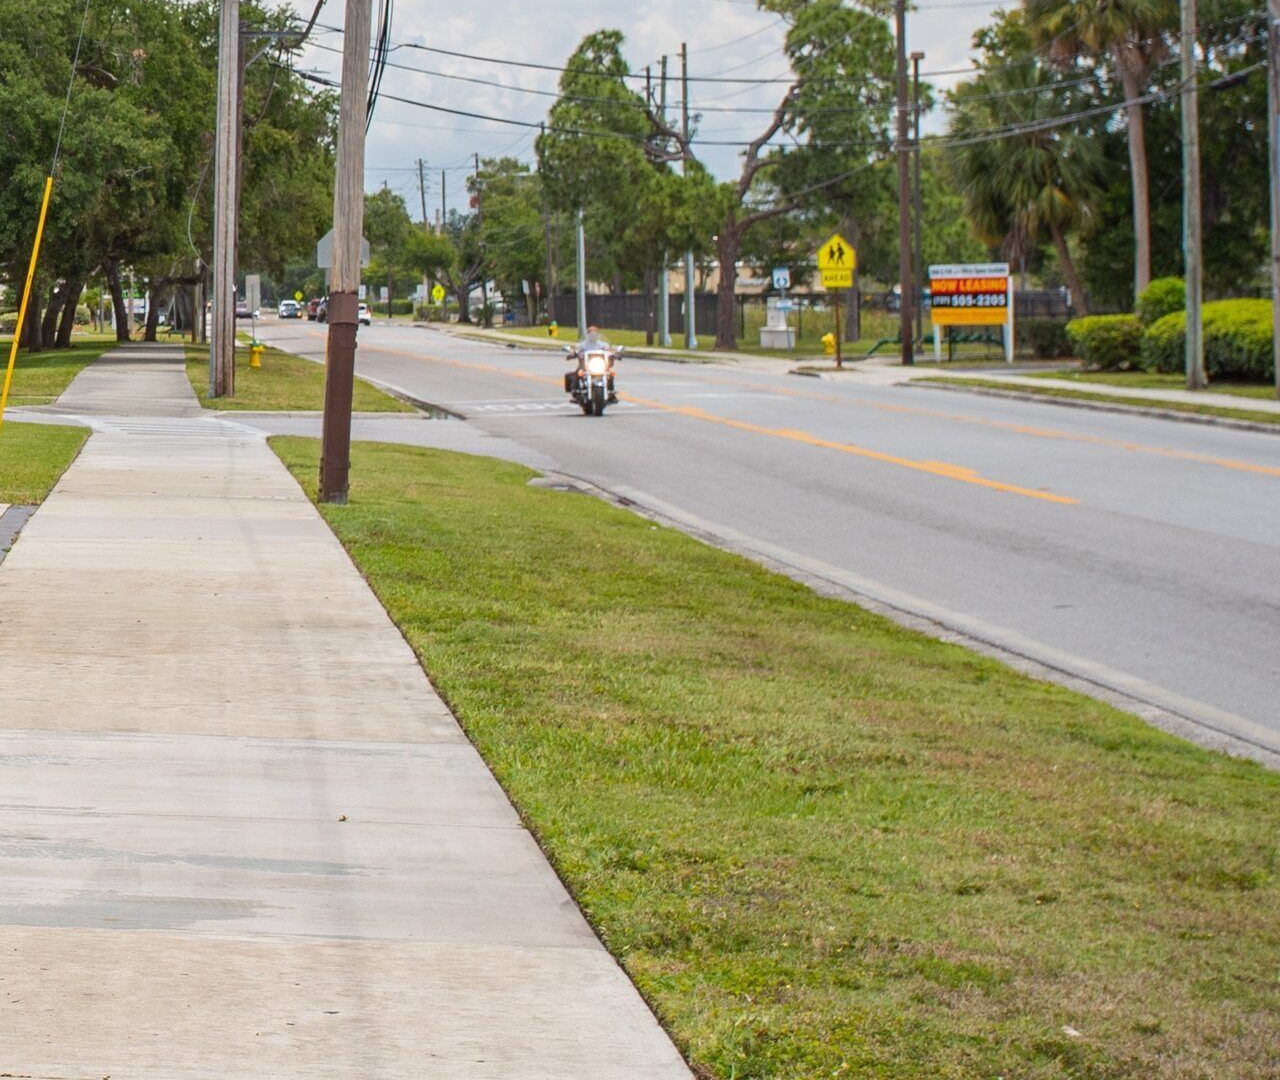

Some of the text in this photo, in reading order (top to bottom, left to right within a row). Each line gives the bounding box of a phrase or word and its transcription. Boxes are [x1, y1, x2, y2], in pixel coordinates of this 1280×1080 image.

[824, 274, 850, 282] AHEAD
[932, 278, 1007, 293] NOW LEASING
